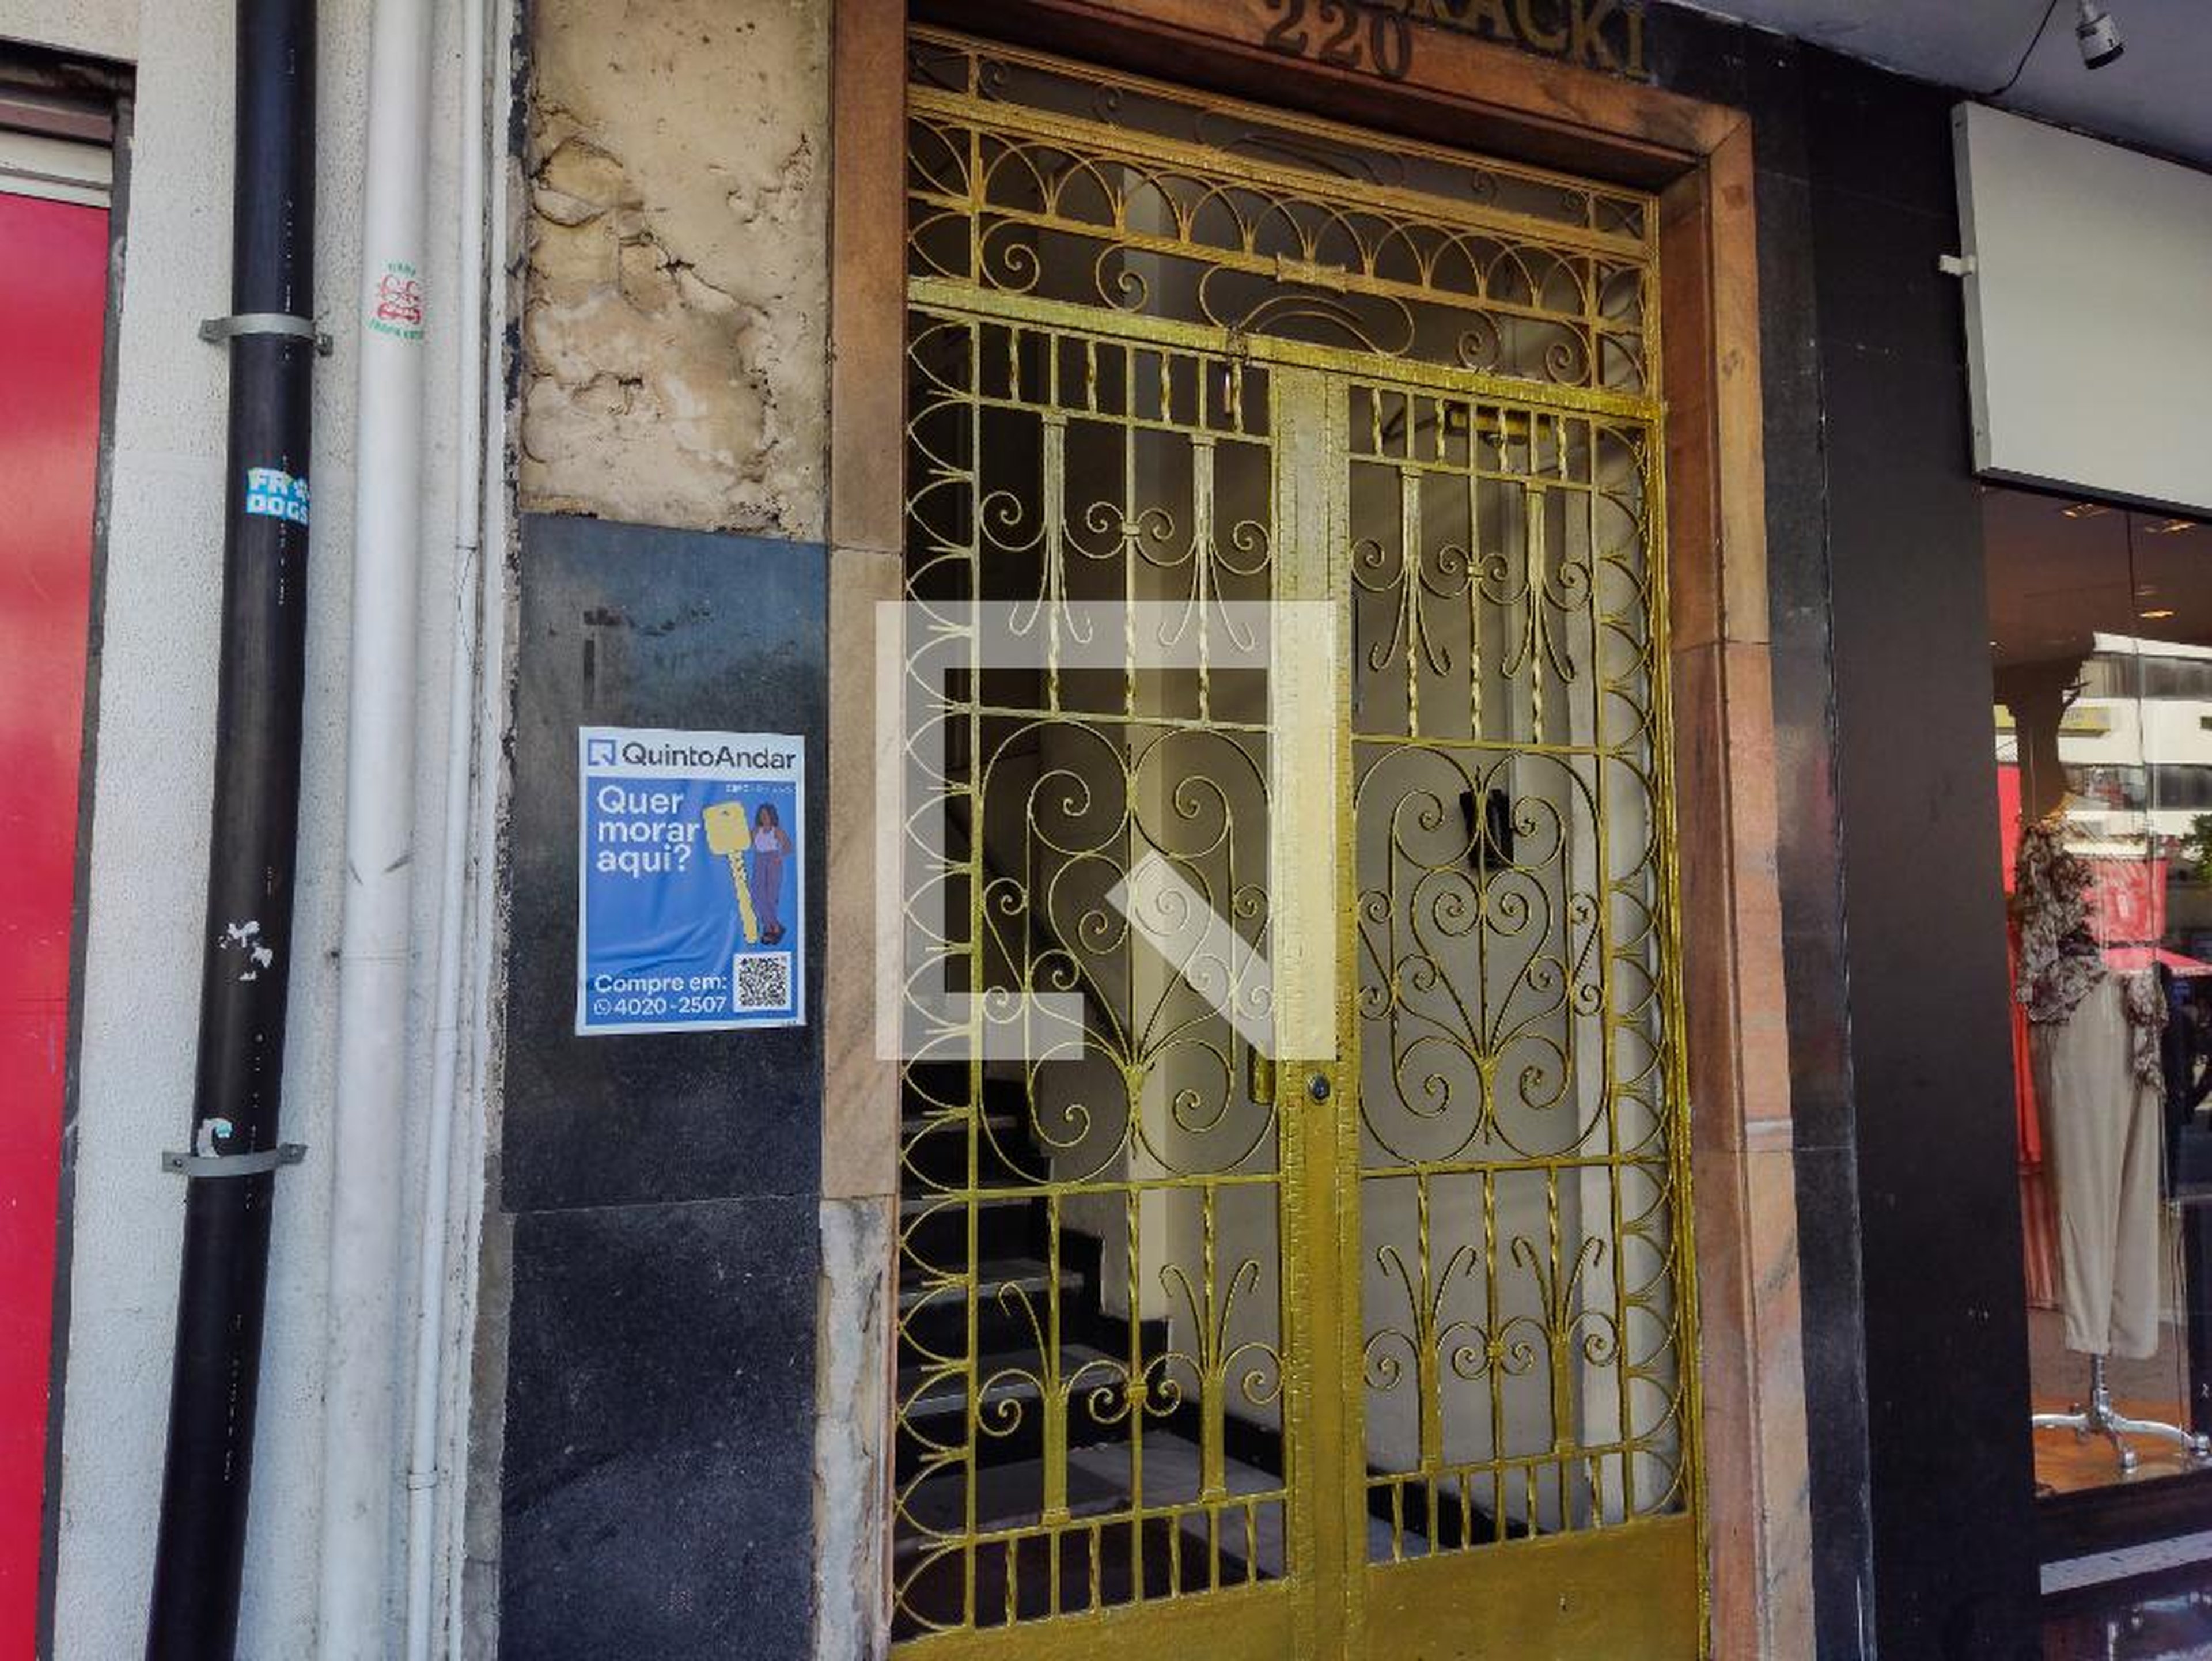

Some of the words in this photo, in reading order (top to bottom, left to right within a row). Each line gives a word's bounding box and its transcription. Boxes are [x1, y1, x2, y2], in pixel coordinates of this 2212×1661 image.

[1263, 0, 1413, 80] 220
[247, 494, 308, 525] DOGS
[622, 741, 797, 770] QuintoAndar
[597, 785, 684, 815] Quer
[597, 819, 699, 843] morar
[597, 843, 691, 877] aqui?
[594, 974, 684, 996] Compre
[688, 975, 728, 991] em:
